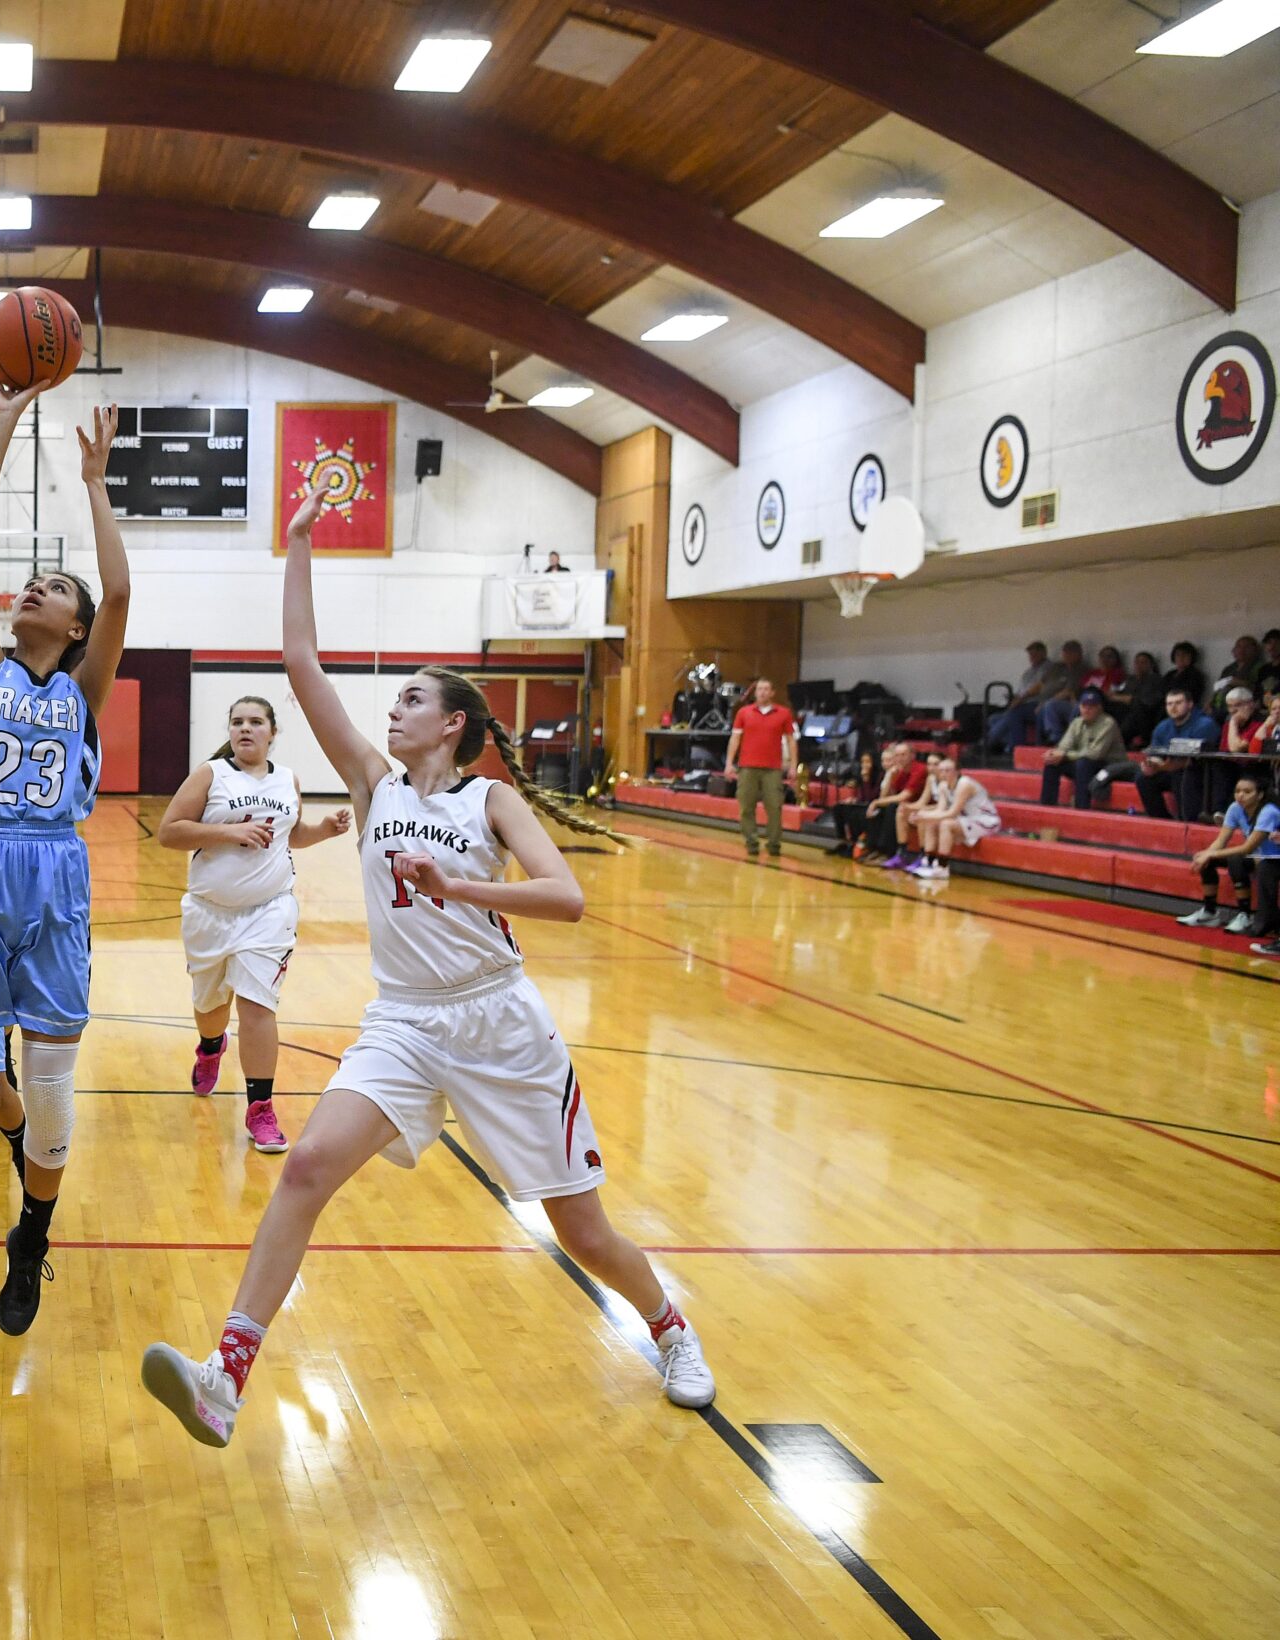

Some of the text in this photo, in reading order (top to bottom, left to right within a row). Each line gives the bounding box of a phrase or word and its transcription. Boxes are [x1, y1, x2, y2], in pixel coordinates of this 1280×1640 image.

[111, 436, 141, 448] HOME
[162, 443, 189, 452] PERIOD
[207, 437, 243, 449] GUEST
[105, 476, 127, 486] FOULS
[151, 477, 200, 486] PLAYER FOUL
[222, 477, 246, 487] FOULS
[228, 795, 291, 815] REDHAWKS
[374, 820, 470, 853] REDHAWKS
